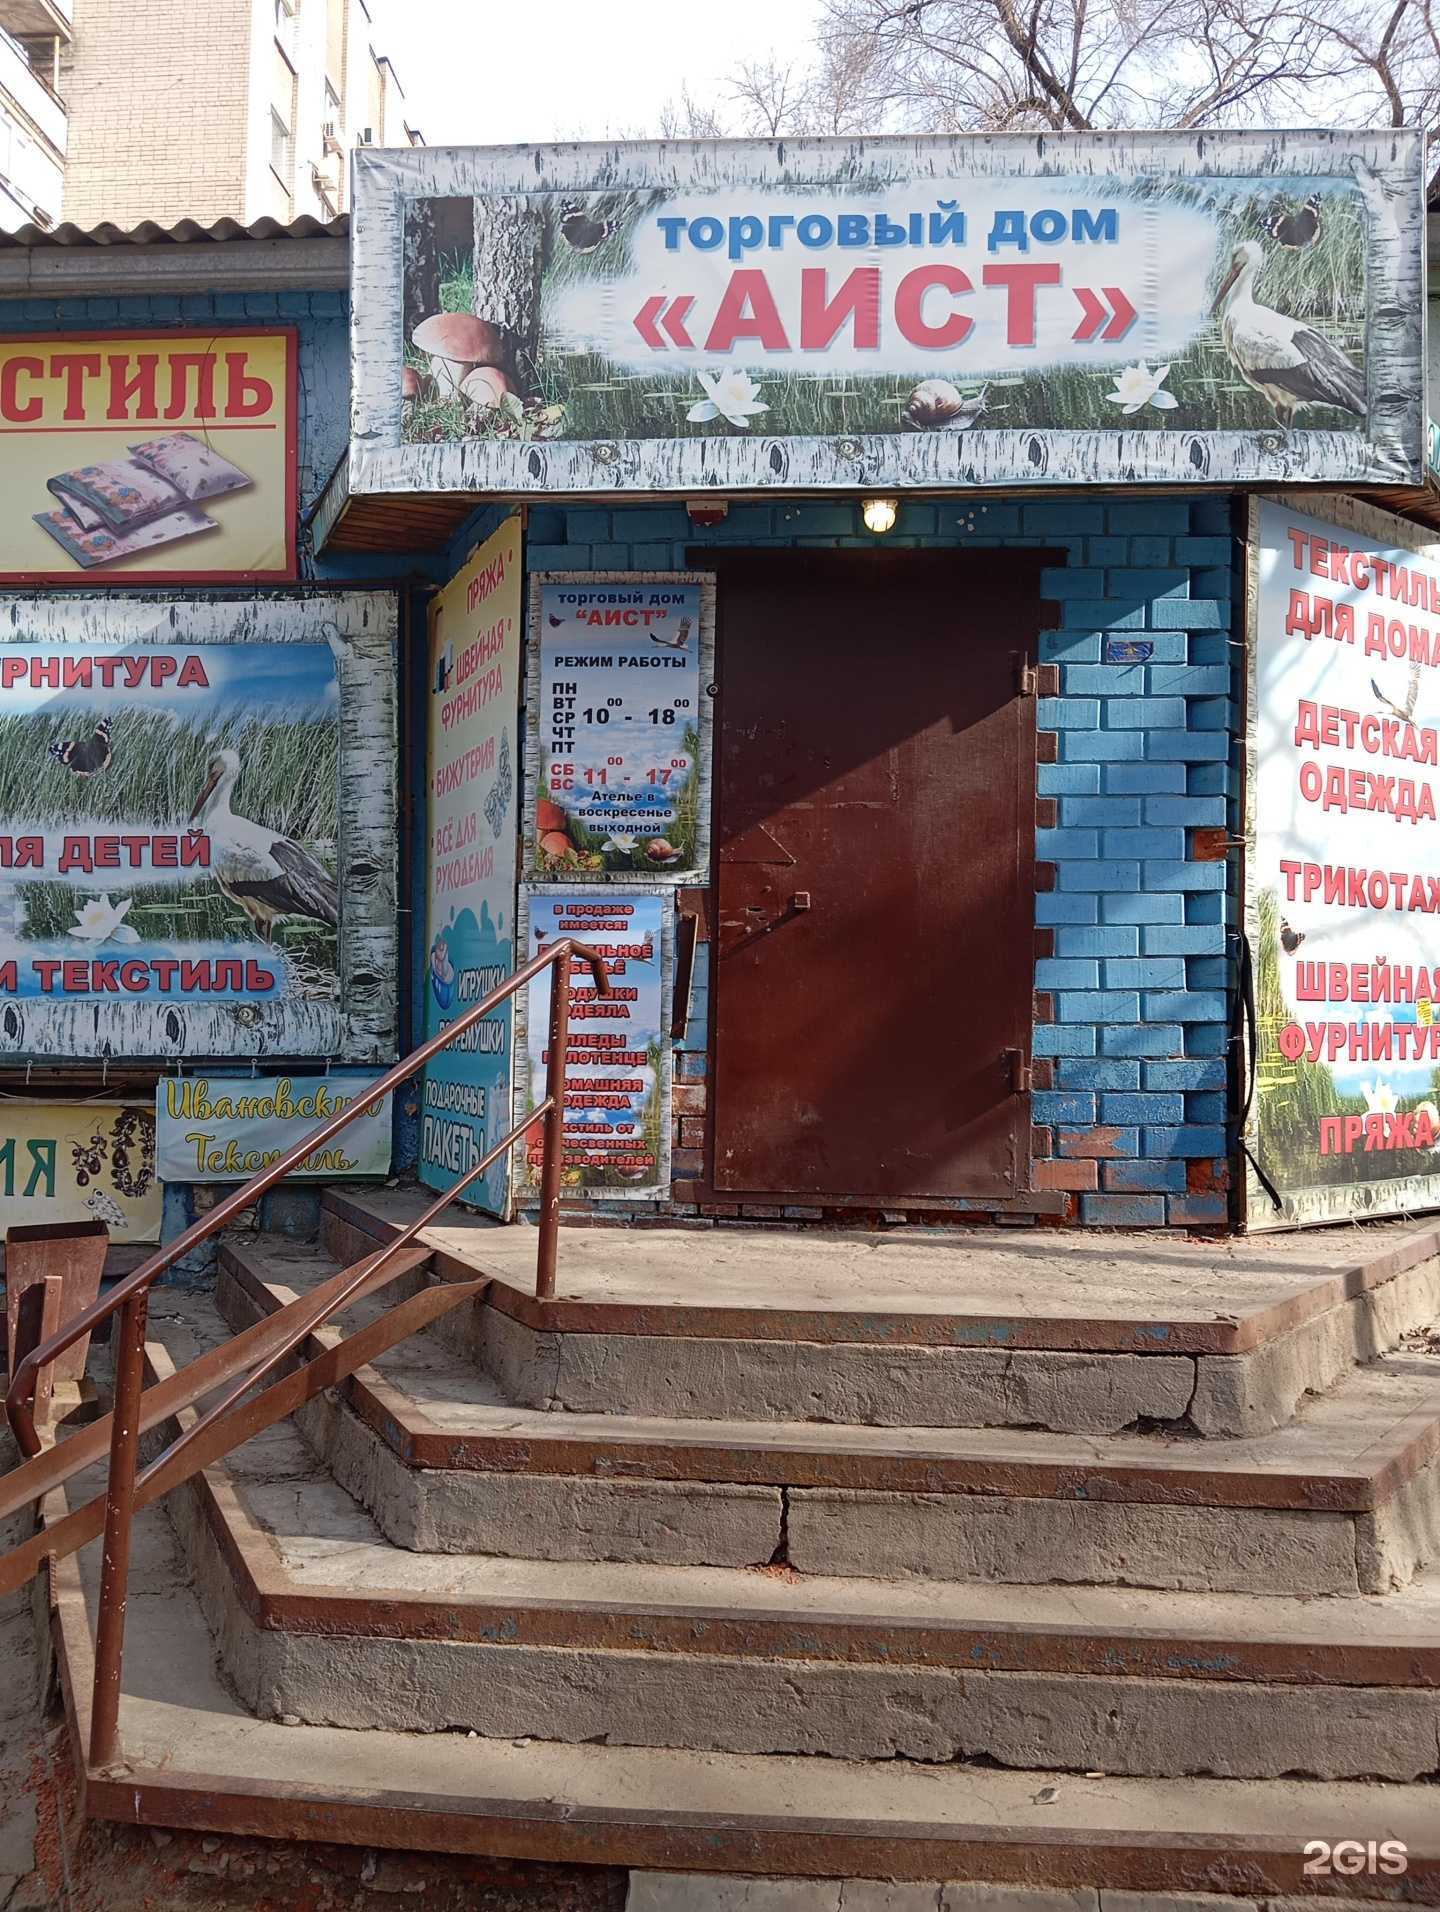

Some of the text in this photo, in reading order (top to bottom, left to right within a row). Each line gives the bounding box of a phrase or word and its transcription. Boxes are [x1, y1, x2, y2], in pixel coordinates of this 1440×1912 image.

[657, 200, 1118, 260] торговый дом
[633, 263, 1138, 352] «АИСТ»
[0, 352, 274, 422] СТИЛЬ
[466, 551, 505, 615] ПРЯЖА
[558, 591, 685, 607] торговый дом
[1286, 588, 1355, 645] ДЛЯ
[456, 618, 504, 686] ШВЕЙНАЯ
[554, 656, 686, 668] РЕЖИМ РАБОТЫ
[0, 655, 210, 688] РНИТУРА
[441, 664, 503, 732] ФУРНИТУРА
[552, 682, 577, 695] ПН
[552, 697, 577, 710] ВТ
[552, 711, 576, 724] СР
[552, 726, 576, 739] ЧТ
[1294, 698, 1438, 766] ДЕТСКАЯ
[551, 741, 576, 754] ПТ
[435, 735, 495, 798] БИЖУТЕРИЯ
[550, 763, 575, 776] СБ
[550, 778, 574, 791] ВС
[591, 790, 656, 802] Ателье в
[1299, 760, 1437, 825] ОДЕЖДА
[578, 807, 673, 819] воскресенье
[436, 812, 477, 857] ВСЁ ДЛЯ
[589, 822, 662, 834] выходной
[58, 829, 211, 873] ДЕТЕЙ
[435, 846, 494, 894] РУКОДЕЛИЯ
[553, 904, 635, 917] в продаже
[558, 919, 628, 931] имеется:
[32, 959, 275, 993] ТЕКСТИЛЬ
[567, 986, 638, 1002] ОДУШКИ
[542, 1050, 648, 1068] ПЛОТЕНЦЕ
[562, 1078, 644, 1093] ОМАШНЯЯ
[424, 1078, 485, 1119] ПОДАРОЧНЫЕ
[615, 1122, 635, 1135] от
[1319, 1110, 1437, 1156] ПРЯЖА
[421, 1113, 485, 1183] ПАКЕТЫ
